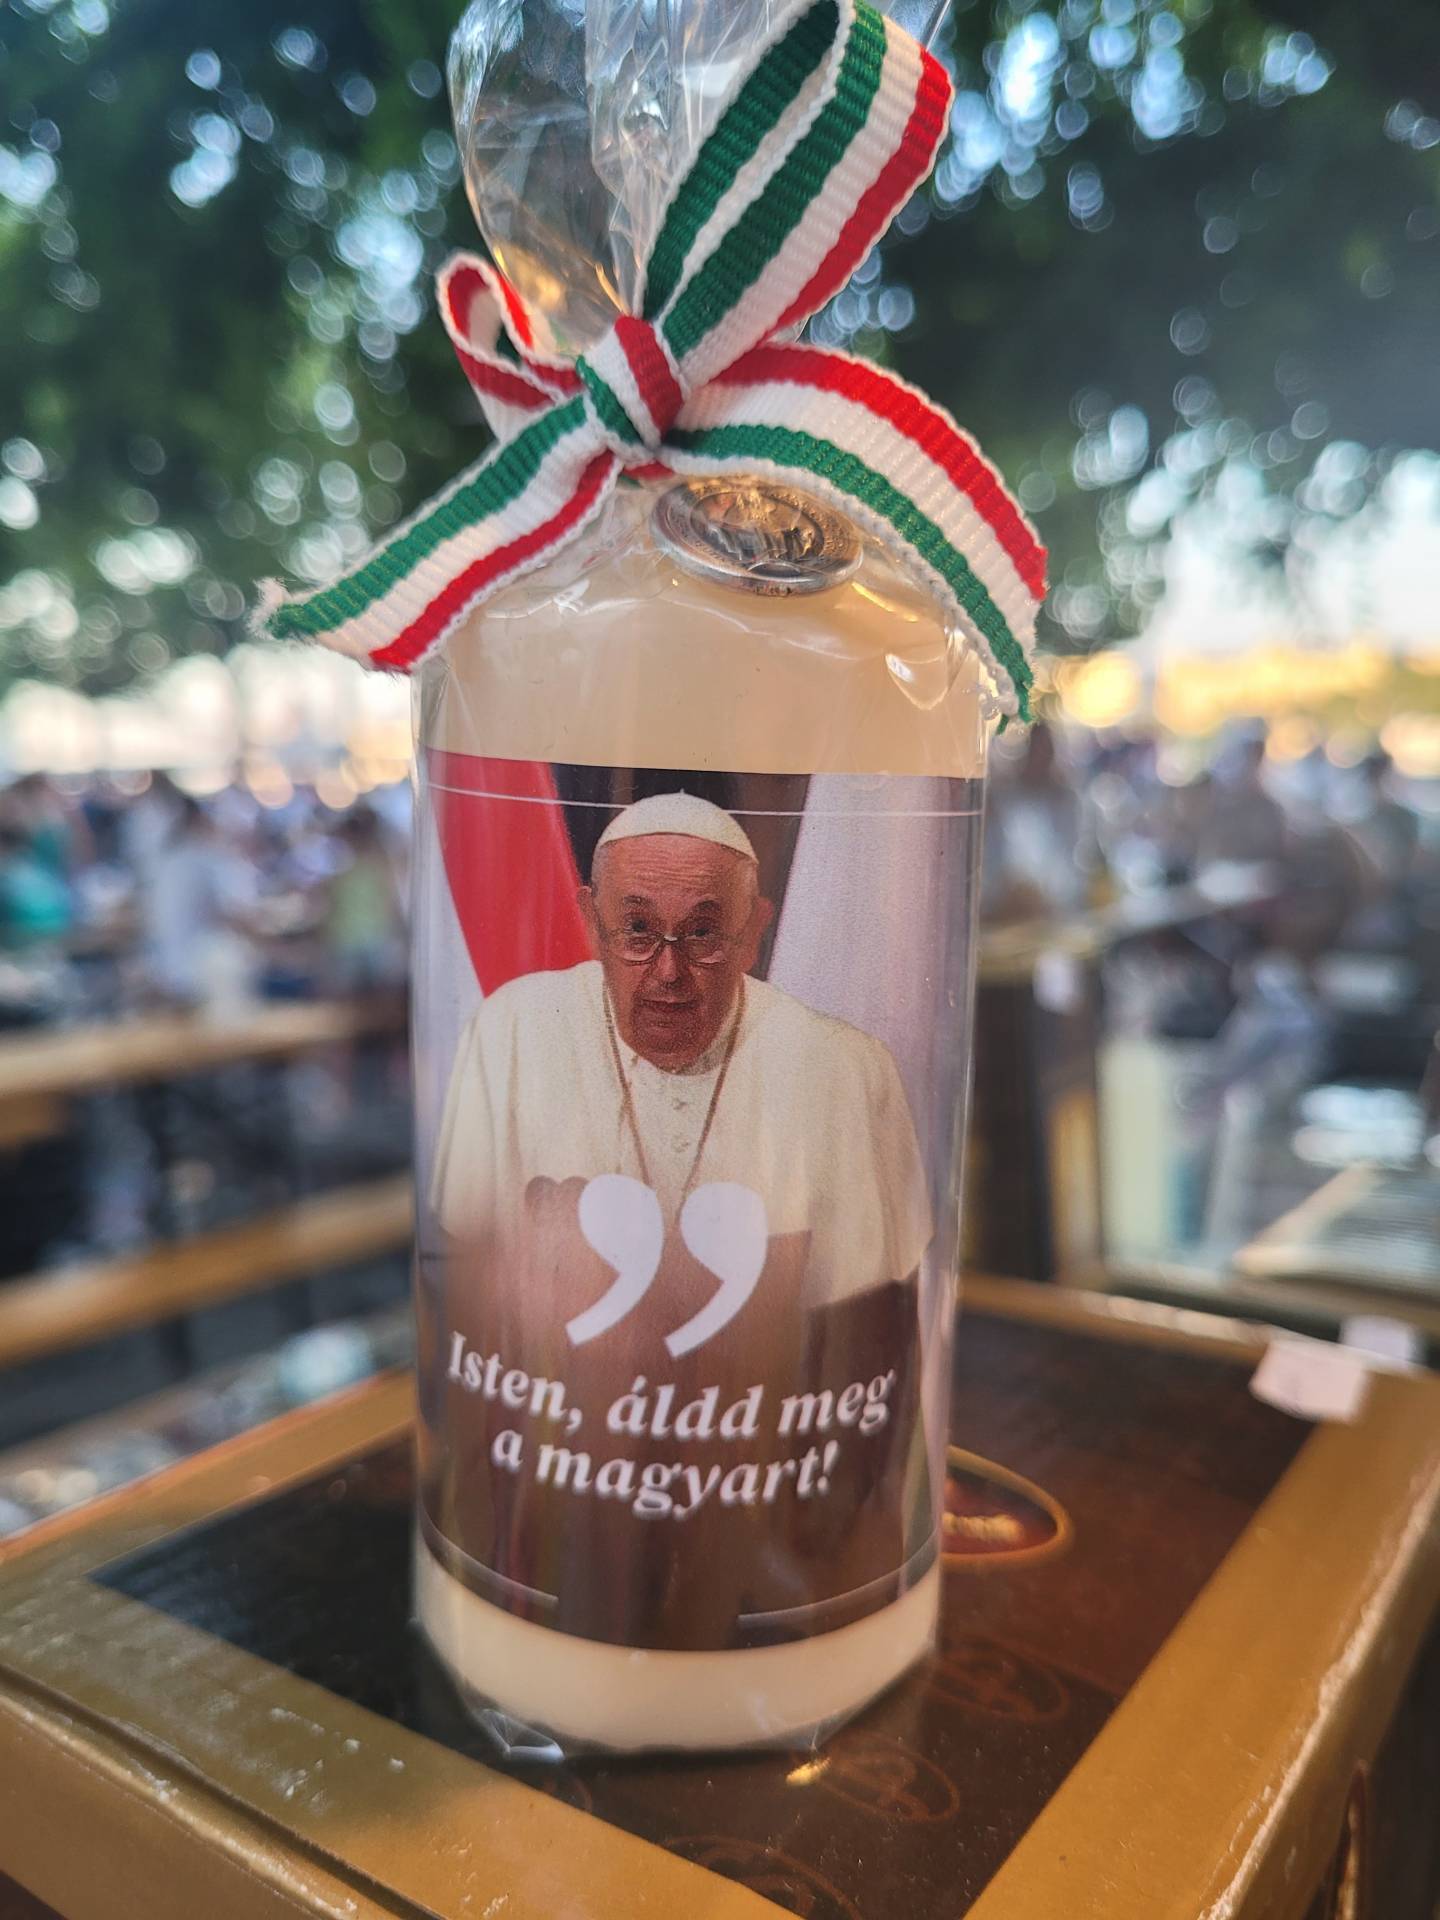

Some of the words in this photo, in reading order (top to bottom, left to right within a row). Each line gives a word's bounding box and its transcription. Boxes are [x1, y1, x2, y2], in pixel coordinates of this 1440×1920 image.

[448, 1331, 583, 1431] Isten,
[606, 1374, 764, 1438] áldd
[778, 1369, 896, 1431] meg
[492, 1428, 523, 1468] a
[536, 1440, 840, 1520] magyart!
